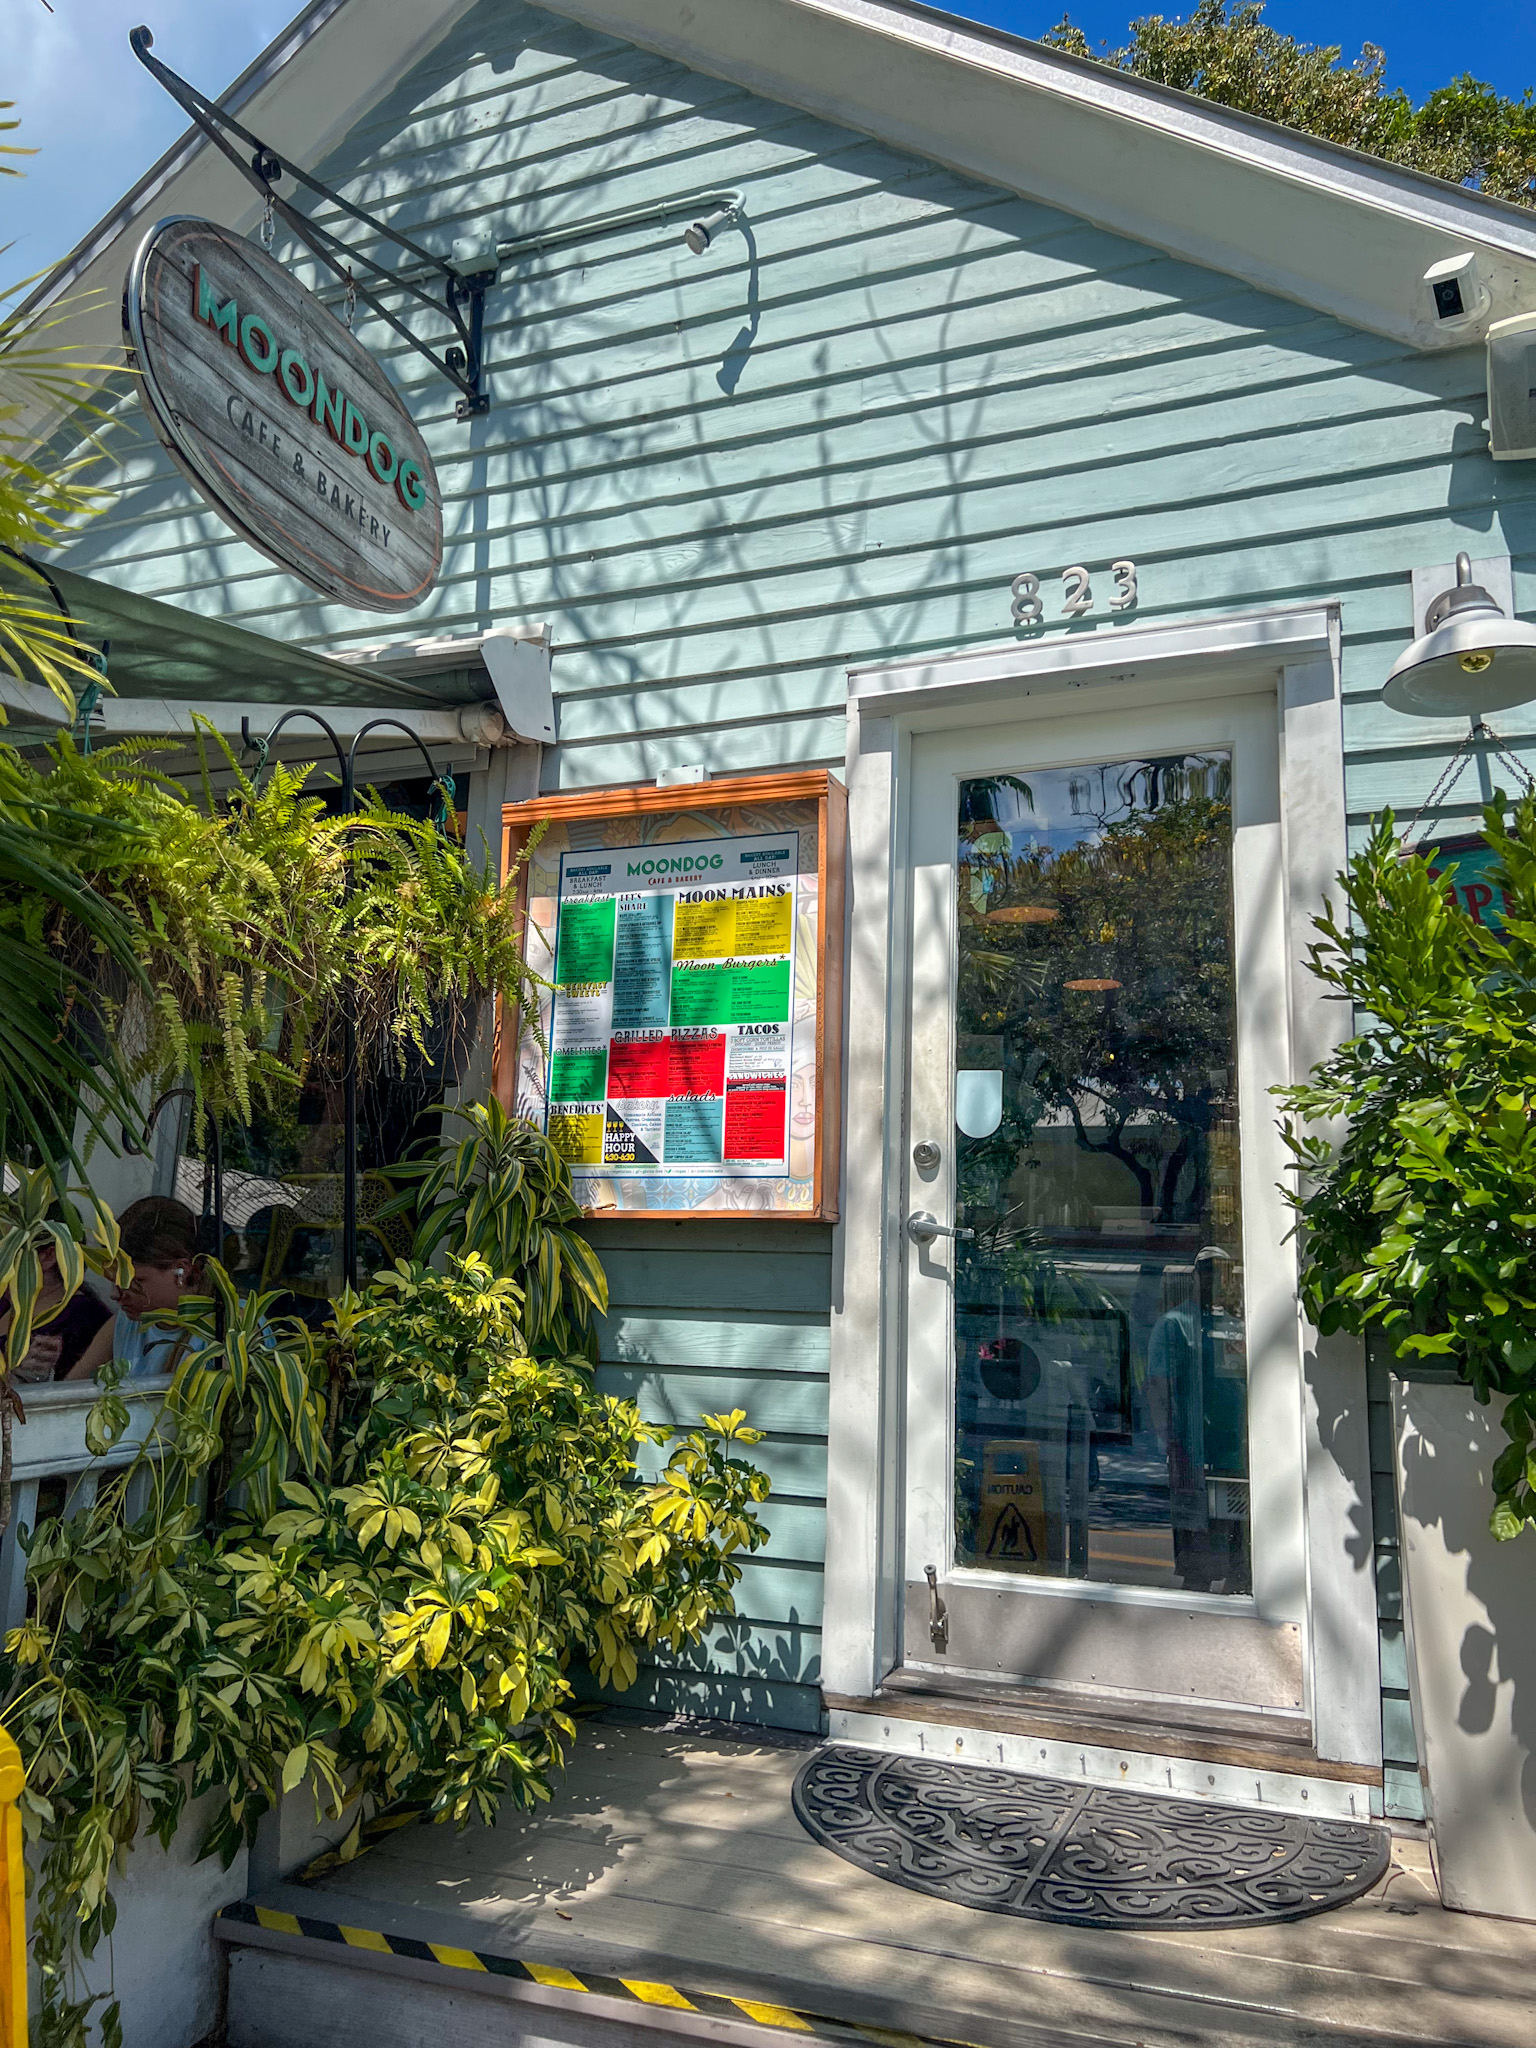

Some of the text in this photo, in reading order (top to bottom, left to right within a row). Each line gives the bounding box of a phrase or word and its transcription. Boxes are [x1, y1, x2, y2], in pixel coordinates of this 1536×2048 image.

[194, 263, 426, 511] MOONDOG
[227, 395, 391, 548] CAFE & BAKERY
[1011, 560, 1137, 620] 823
[627, 854, 723, 876] MOONDOG
[570, 876, 606, 884] BREAKFAST
[648, 877, 665, 886] CAFE
[675, 874, 702, 883] BAKERY
[620, 893, 642, 902] LET'S
[679, 888, 726, 904] MOON
[620, 903, 647, 911] SHARE
[676, 960, 716, 972] Moon
[566, 989, 600, 998] SWEETS
[615, 1027, 718, 1043] GRILLED PIZZAS
[737, 1024, 779, 1035] TACOS
[729, 1072, 784, 1080] SANDWICHES
[668, 1089, 717, 1102] salads
[605, 1133, 636, 1142] HAPPY
[605, 1142, 635, 1153] HOUR
